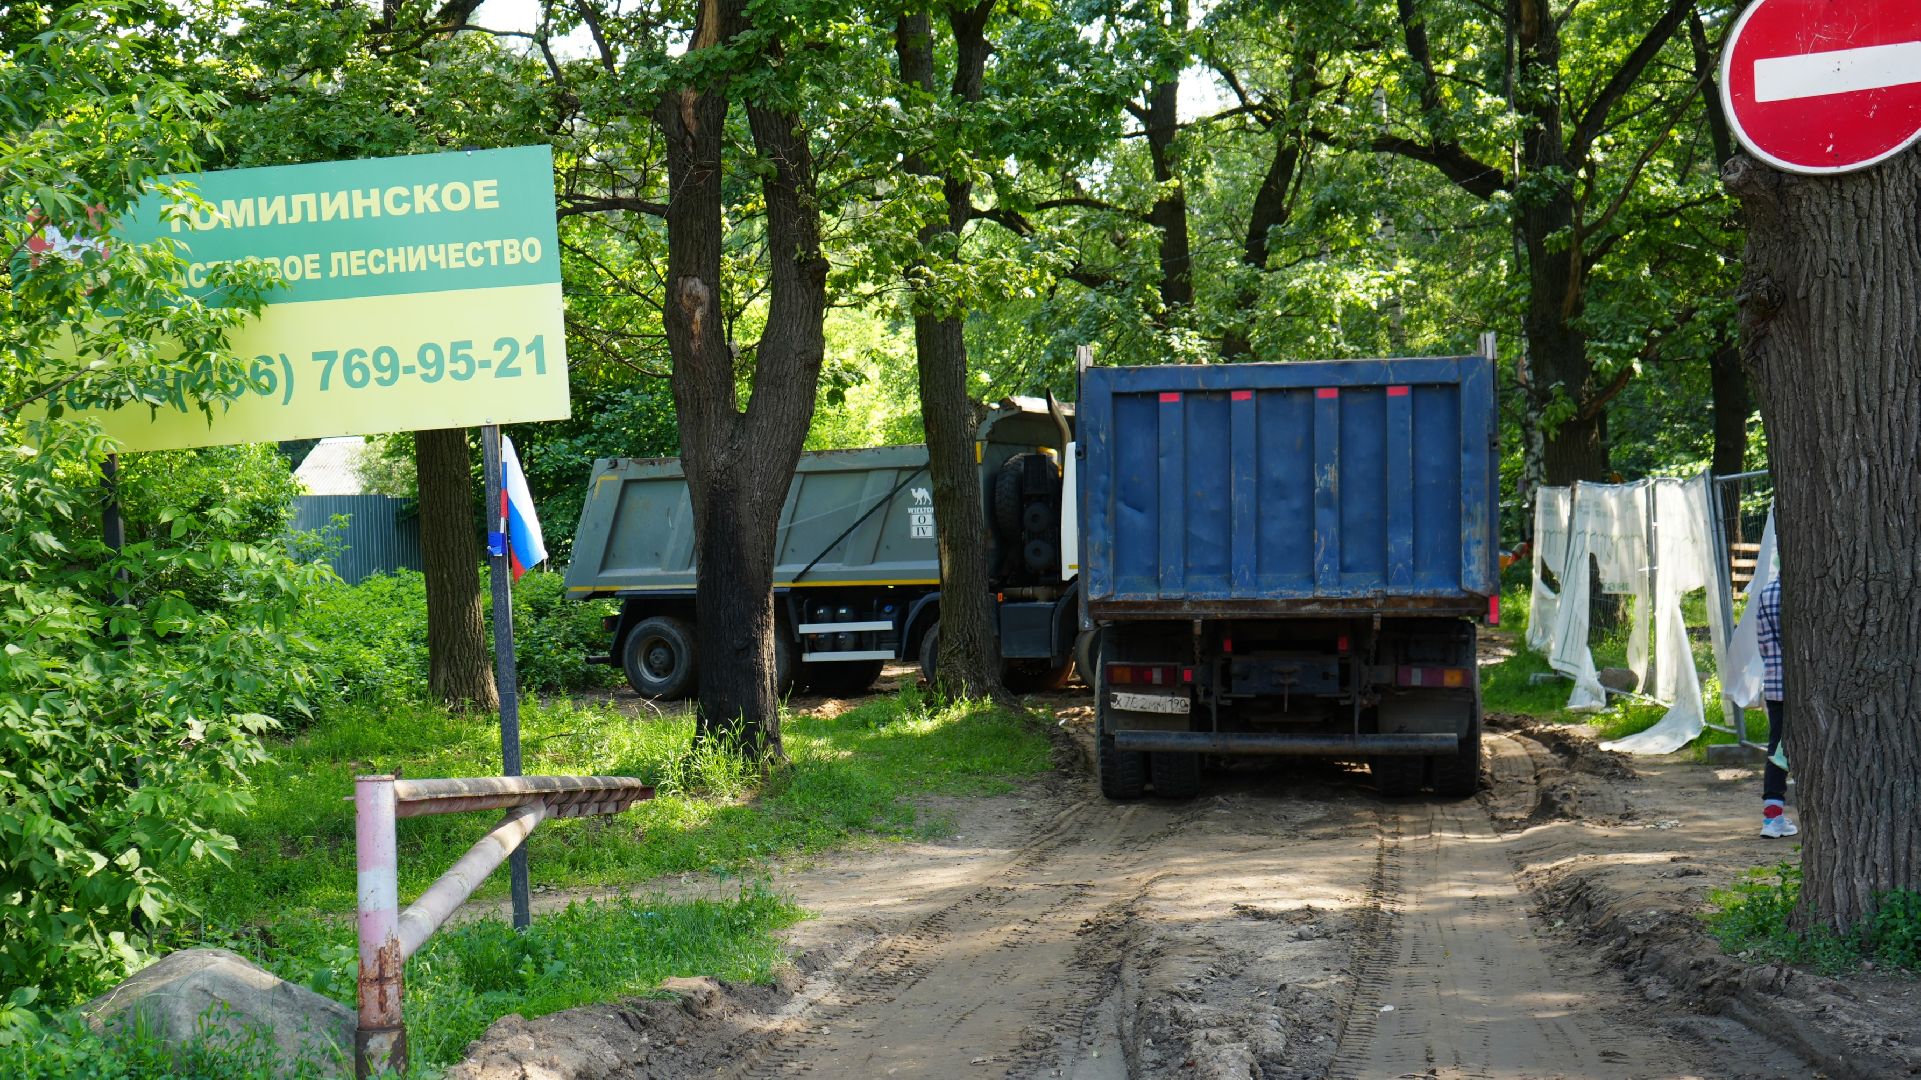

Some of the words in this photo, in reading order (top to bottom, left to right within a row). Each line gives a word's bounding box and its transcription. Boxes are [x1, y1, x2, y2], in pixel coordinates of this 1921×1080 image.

[160, 179, 500, 233] ТОМИЛИНСКОЕ
[140, 253, 322, 290] АСВОЕ
[329, 236, 542, 278] ЛЕСНИЧЕСТВО
[311, 334, 547, 391] 769-95-21
[916, 527, 928, 536] IV
